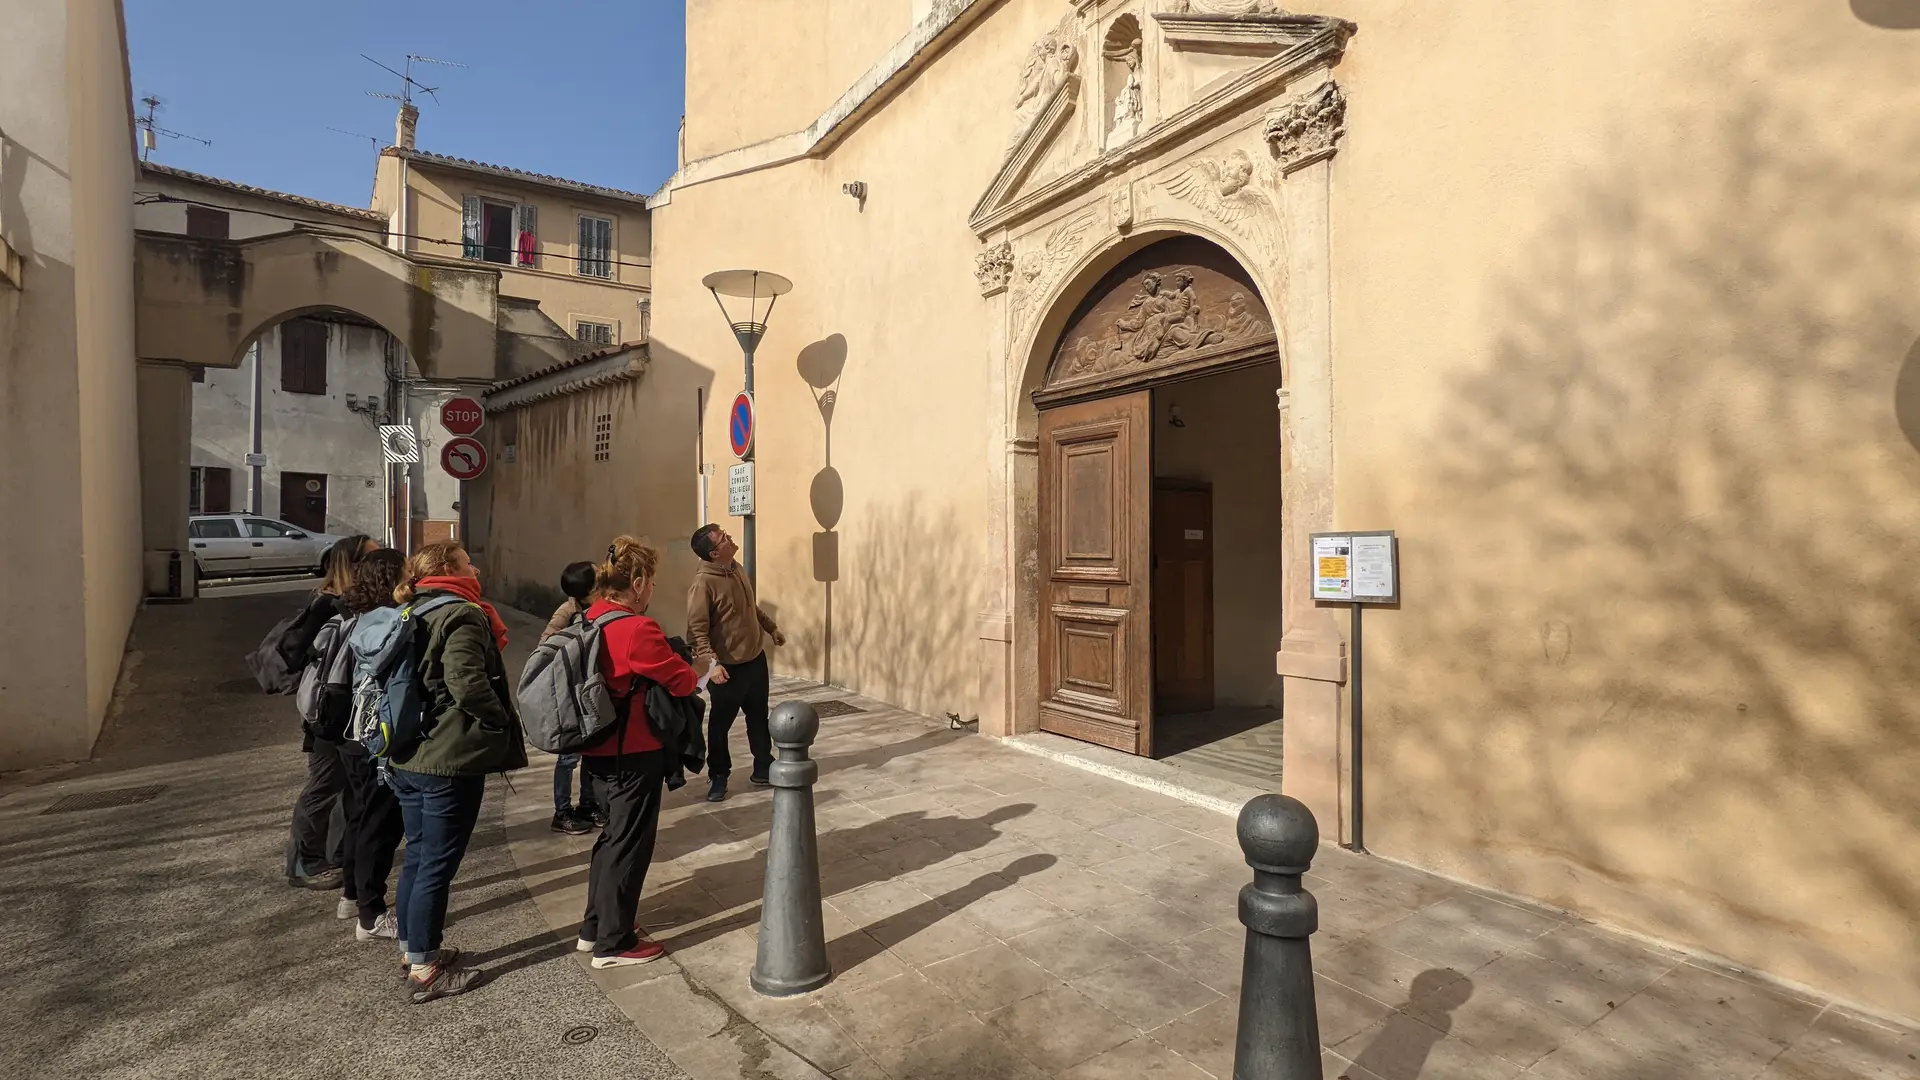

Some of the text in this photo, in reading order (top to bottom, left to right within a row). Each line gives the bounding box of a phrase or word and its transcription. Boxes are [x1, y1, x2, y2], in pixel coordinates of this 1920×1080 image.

[446, 410, 480, 422] STOP
[735, 467, 744, 475] SAUF
[731, 475, 749, 485] CONVOIS
[730, 485, 751, 494] RELIGIEUX
